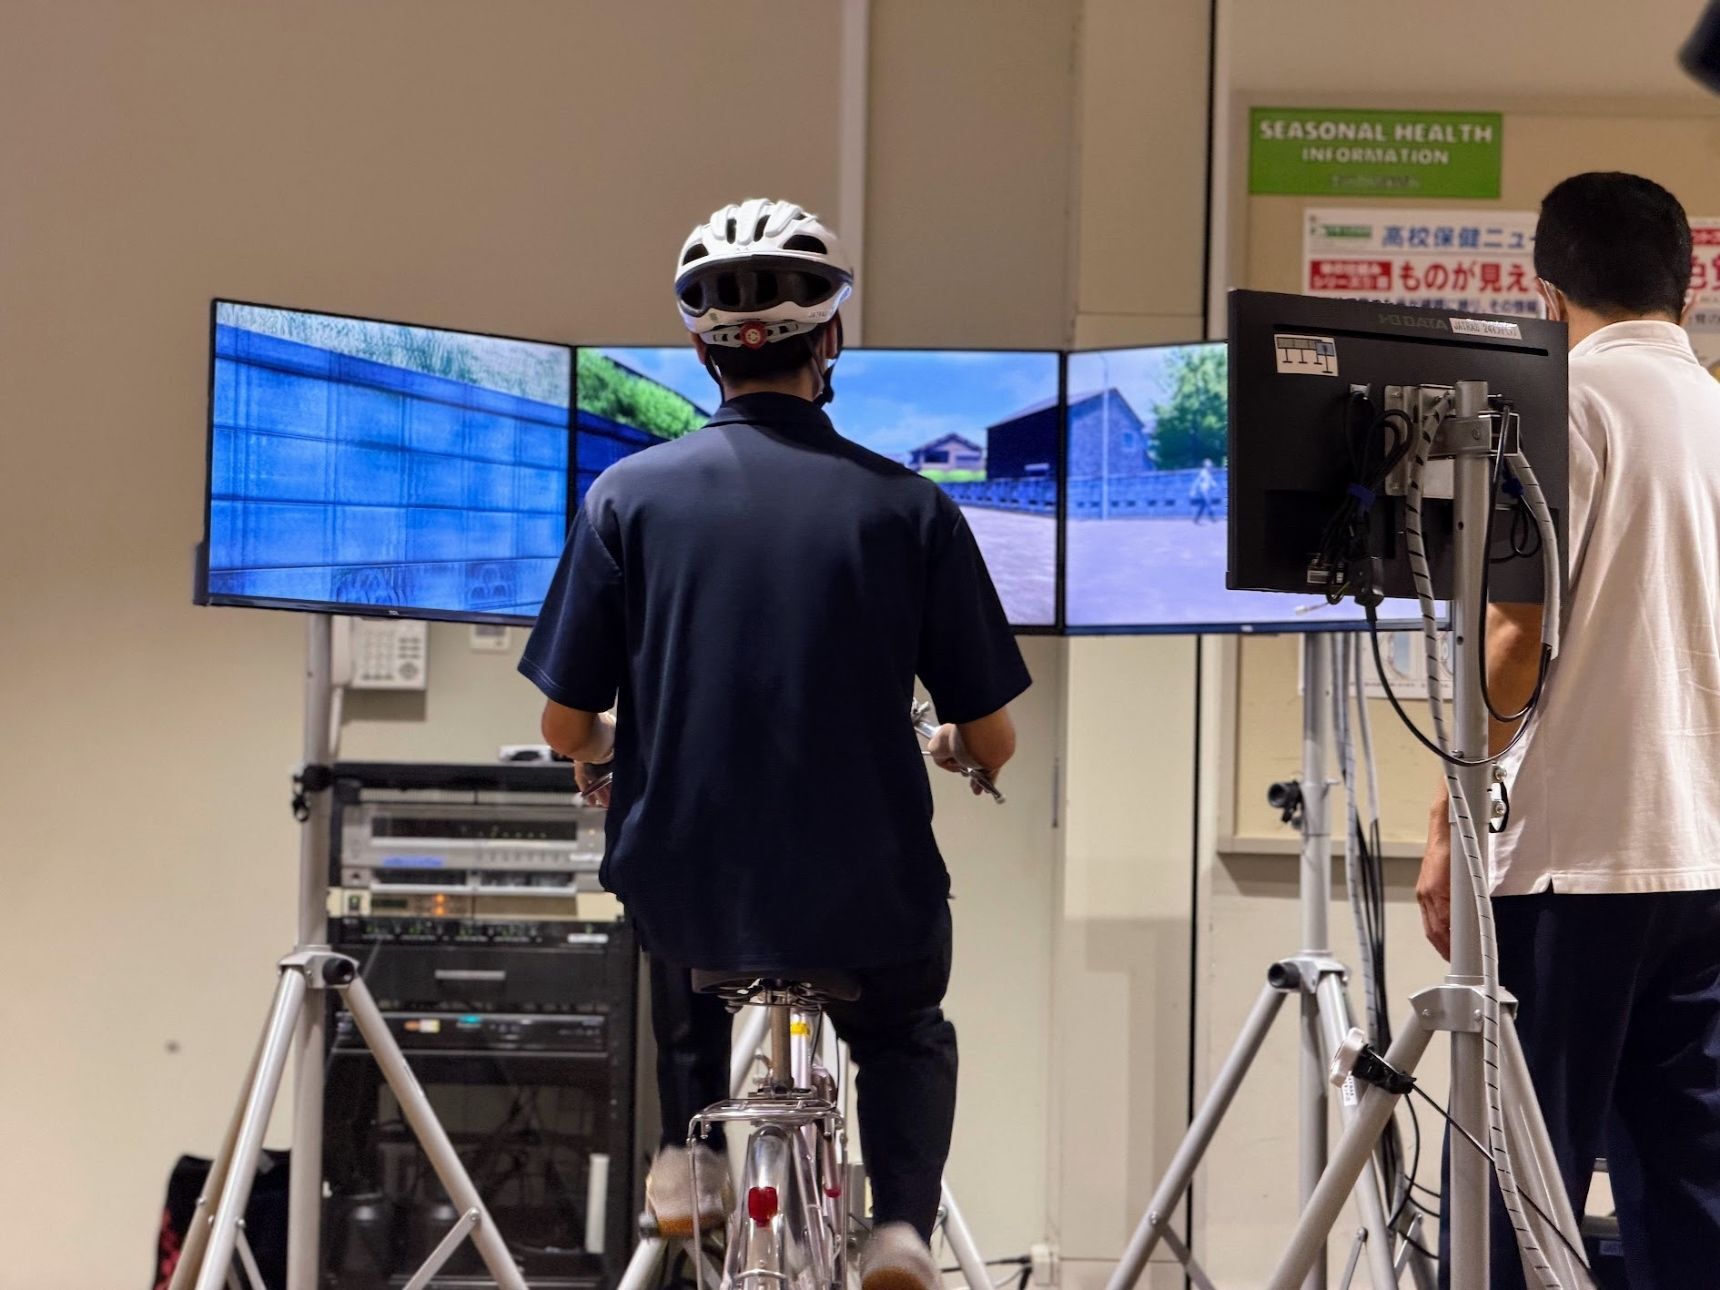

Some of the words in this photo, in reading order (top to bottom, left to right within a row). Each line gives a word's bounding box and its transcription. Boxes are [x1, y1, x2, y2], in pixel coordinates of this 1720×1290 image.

[1260, 120, 1386, 141] SEASONAL
[1394, 122, 1493, 143] HEALTH
[1302, 147, 1449, 165] INFORMATION
[1382, 225, 1536, 249] 高校保健ニュ
[1400, 261, 1534, 293] ものが見え
